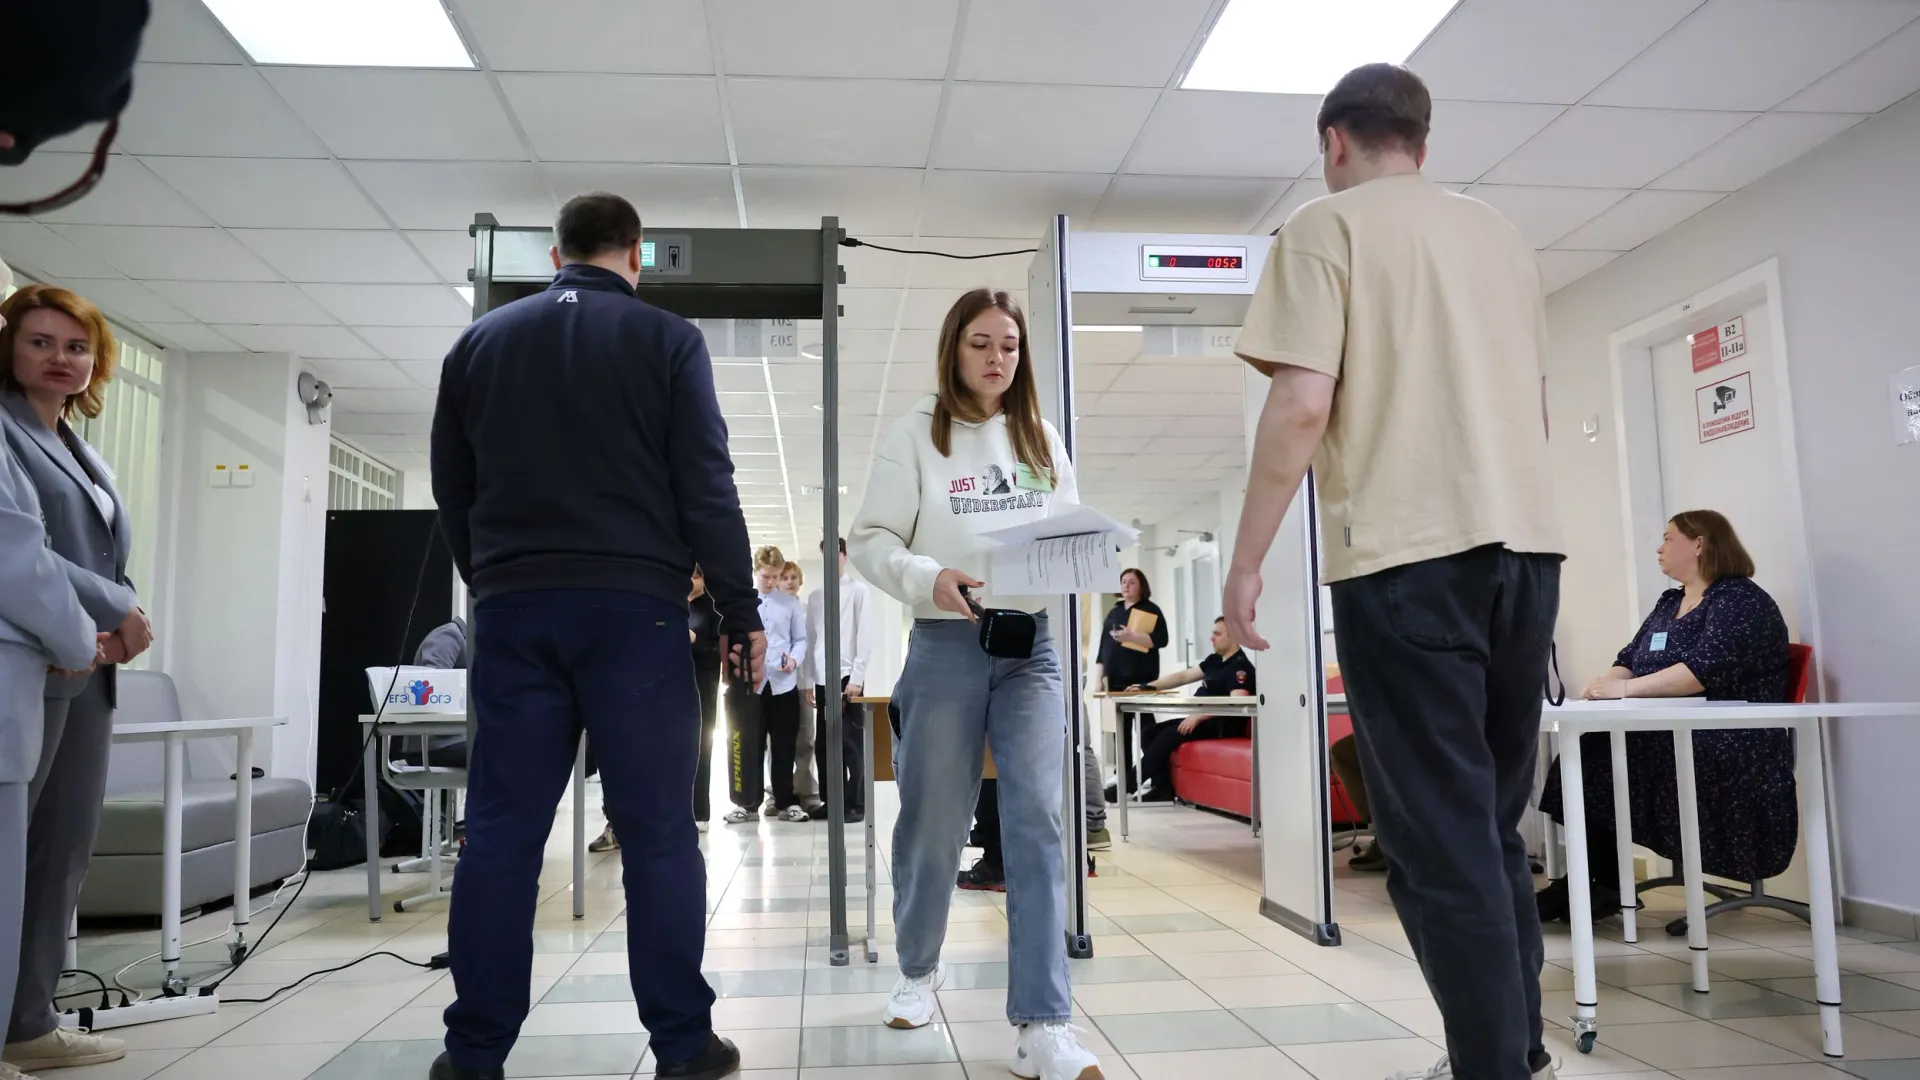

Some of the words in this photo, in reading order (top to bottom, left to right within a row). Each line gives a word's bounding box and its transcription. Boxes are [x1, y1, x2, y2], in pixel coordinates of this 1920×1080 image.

[1169, 257, 1177, 267] 0
[1207, 258, 1237, 268] 0052
[949, 477, 976, 493] JUST
[950, 491, 1044, 514] UNDERSTAND
[389, 694, 408, 704] ЕГЭ
[430, 694, 452, 704] ОГЭ
[733, 730, 742, 793] SPHINX
